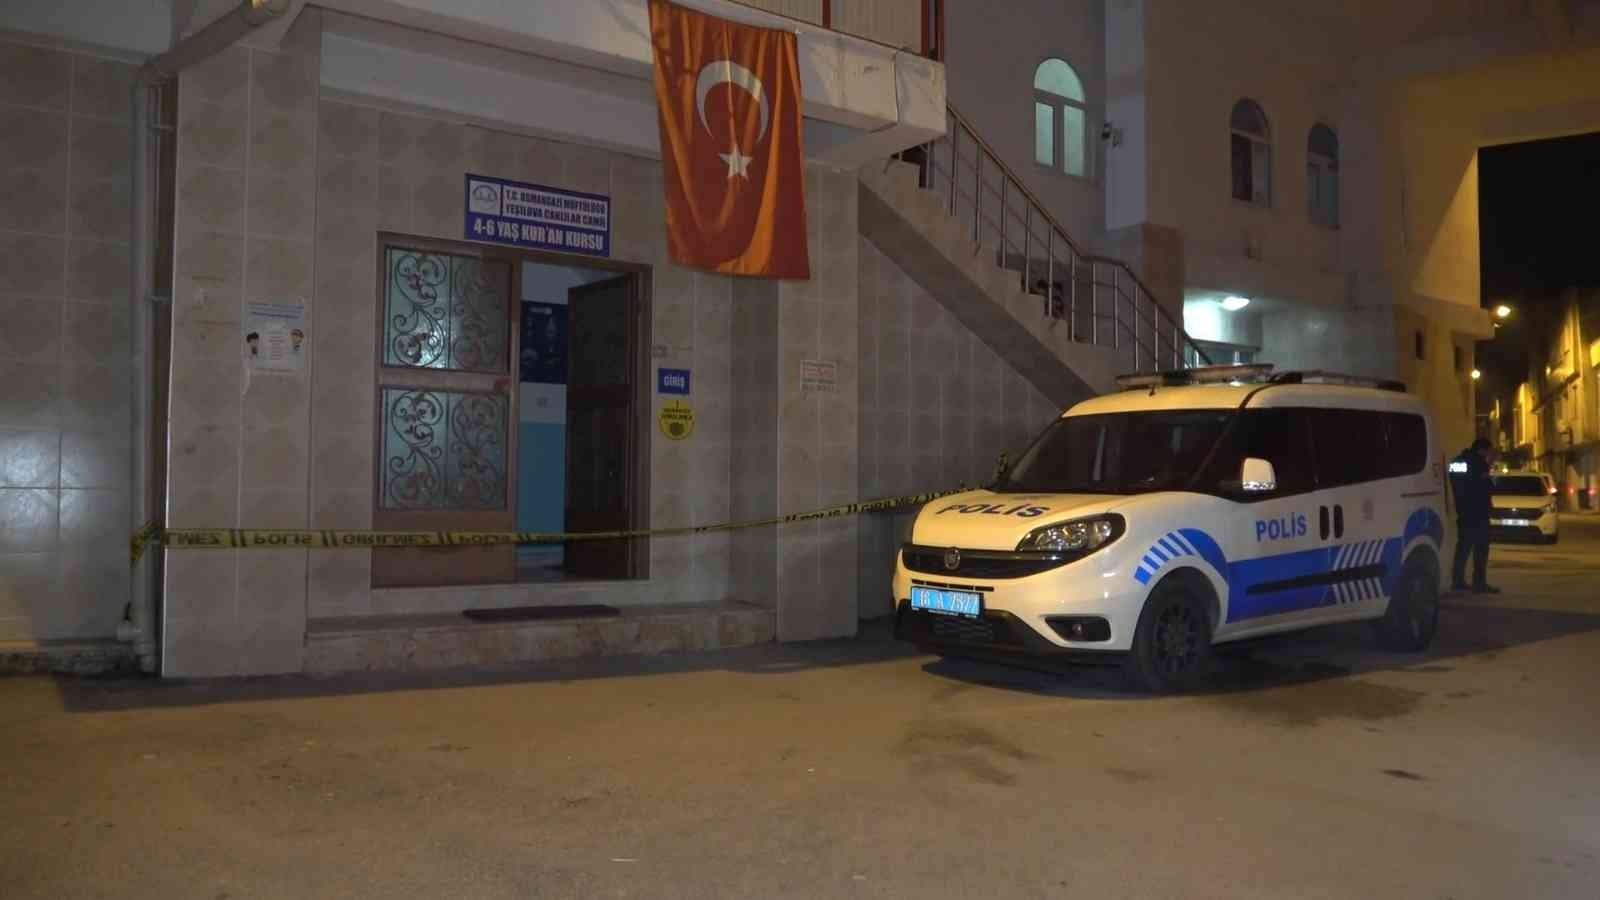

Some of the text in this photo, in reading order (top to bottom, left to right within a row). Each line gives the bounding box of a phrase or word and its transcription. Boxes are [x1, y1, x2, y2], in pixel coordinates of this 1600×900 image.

[473, 217, 604, 250] 4-6 YAŞ KUR'AN KURSU
[1255, 511, 1308, 541] POLİS
[936, 591, 945, 610] A
